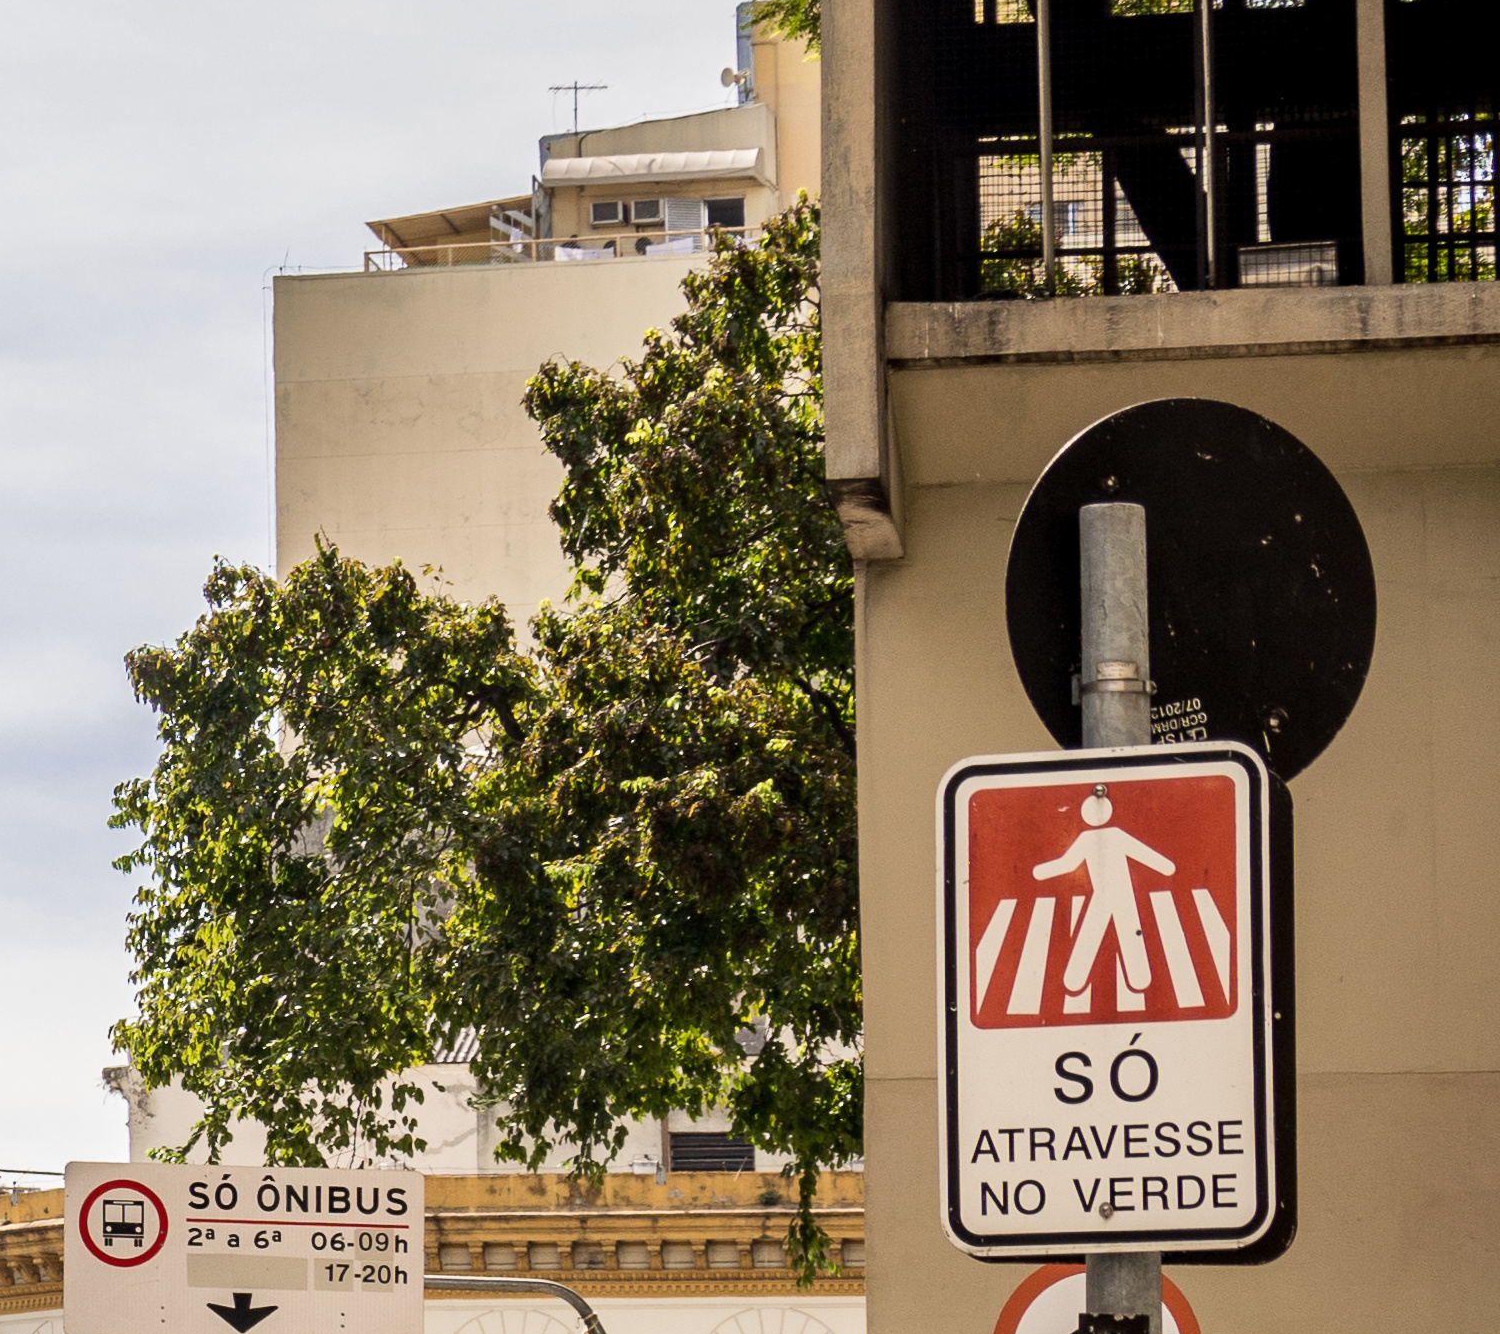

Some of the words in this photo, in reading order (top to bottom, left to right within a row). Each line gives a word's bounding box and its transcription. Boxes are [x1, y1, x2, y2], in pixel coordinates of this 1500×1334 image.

[1054, 1032, 1160, 1104] SÓ
[970, 1120, 1245, 1164] ATRAVESSE
[187, 1173, 238, 1211] SÓ
[256, 1175, 408, 1216] ÔNIBUS
[980, 1179, 1047, 1216] NO
[1072, 1173, 1238, 1213] VERDE
[187, 1228, 215, 1246] 2ª
[227, 1234, 240, 1248] a
[253, 1230, 283, 1249] 6ª
